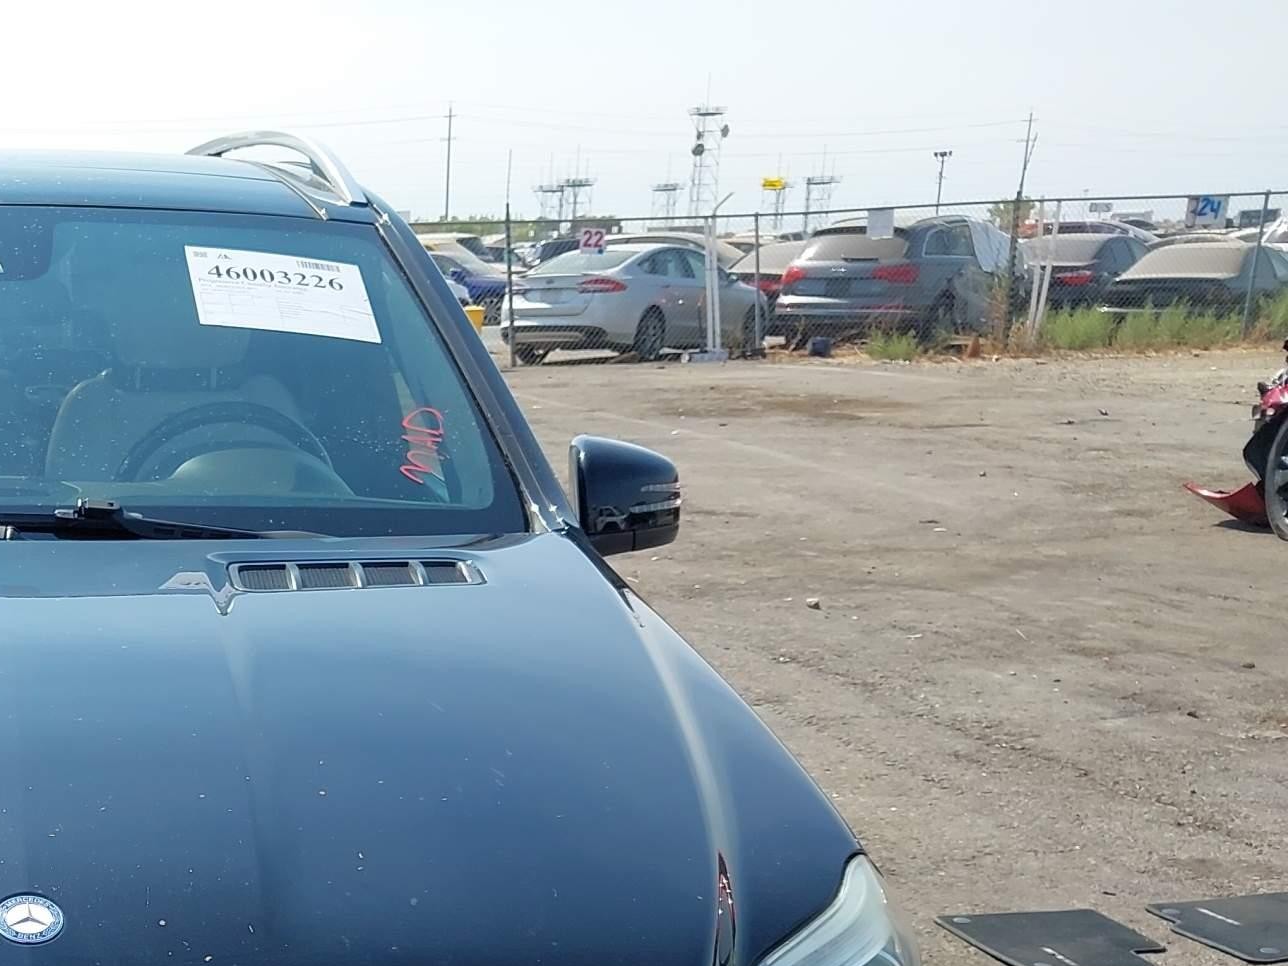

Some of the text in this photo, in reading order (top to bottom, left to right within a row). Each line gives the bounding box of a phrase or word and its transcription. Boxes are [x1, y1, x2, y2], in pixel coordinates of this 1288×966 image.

[1197, 197, 1222, 219] 24
[583, 230, 604, 248] 22
[207, 264, 344, 291] 46003226
